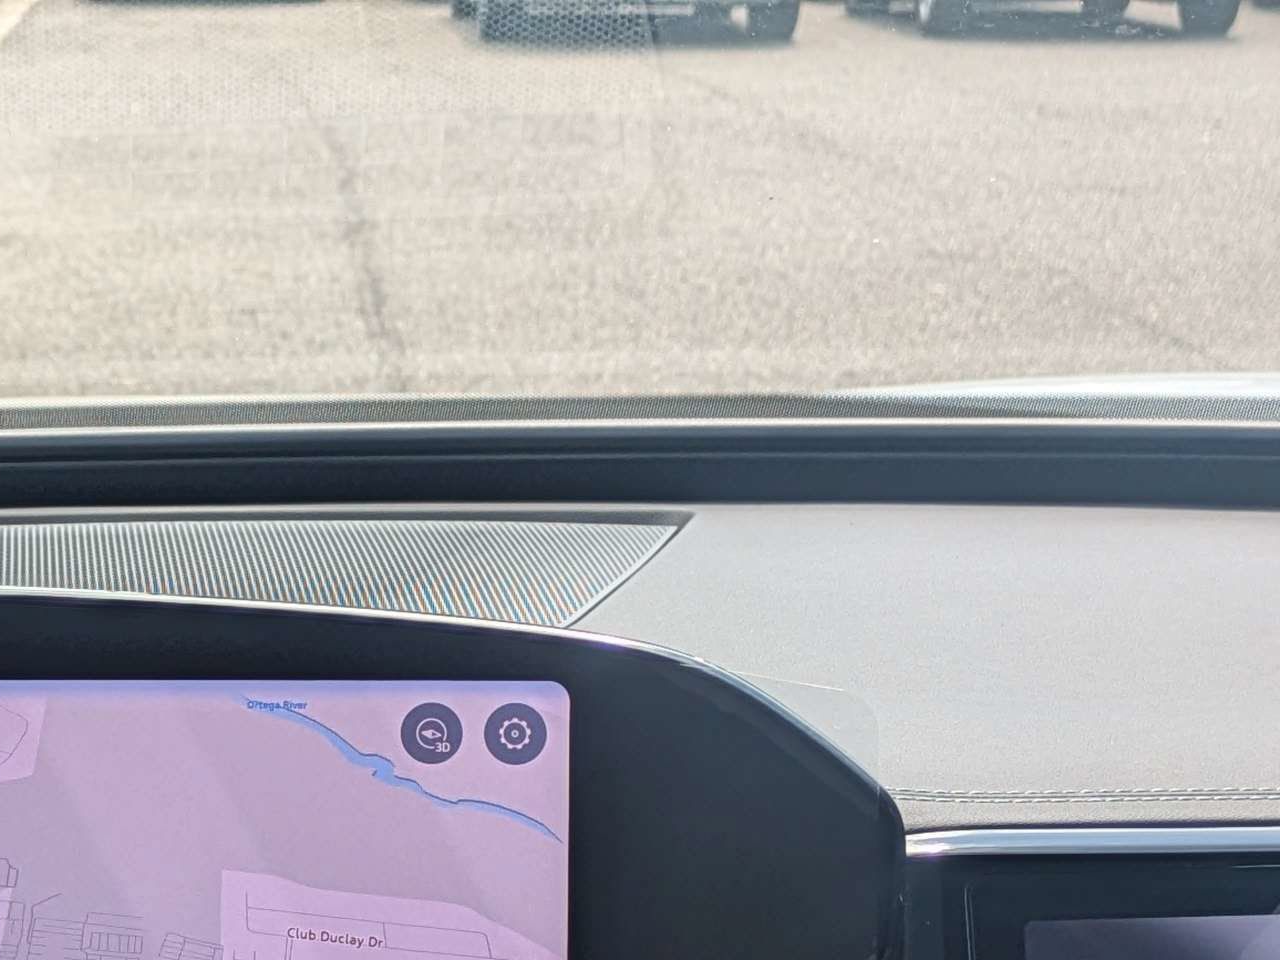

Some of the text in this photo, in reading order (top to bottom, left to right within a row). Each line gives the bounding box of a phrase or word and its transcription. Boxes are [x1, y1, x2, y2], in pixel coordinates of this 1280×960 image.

[247, 700, 308, 712] Ortega River
[435, 742, 451, 753] 3D
[287, 927, 384, 949] Club Duclay Dr
